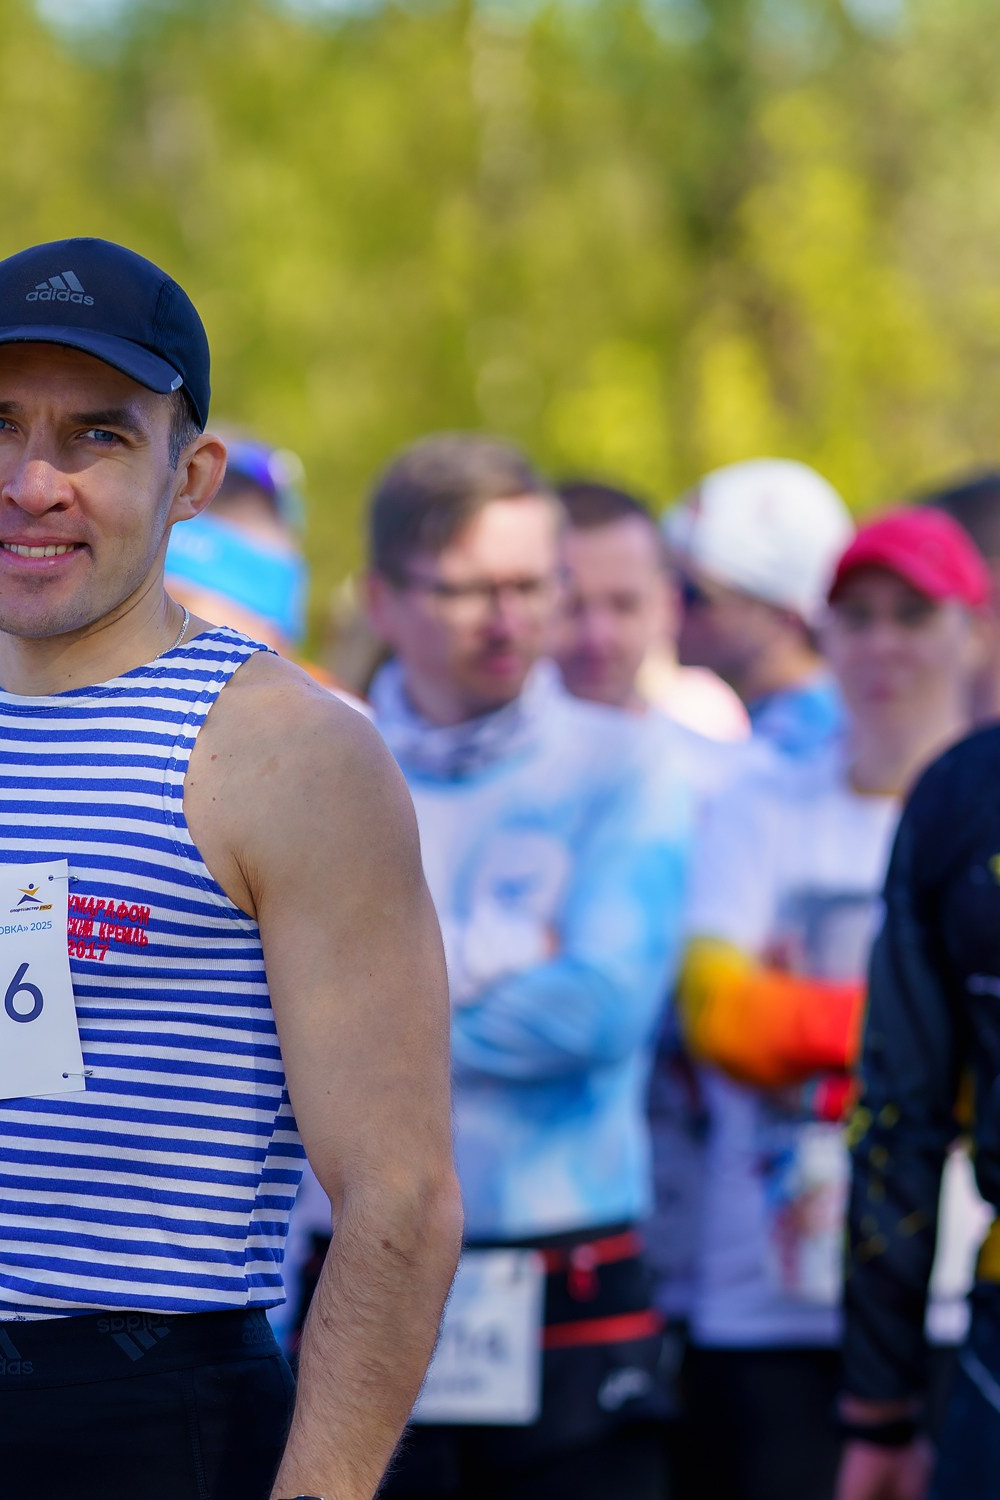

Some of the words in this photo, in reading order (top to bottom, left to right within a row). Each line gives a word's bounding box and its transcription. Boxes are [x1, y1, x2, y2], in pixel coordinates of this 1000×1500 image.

[25, 287, 95, 306] adidas
[30, 920, 53, 932] 2025
[98, 920, 149, 949] КРЕМЛЬ
[68, 939, 110, 962] 2017
